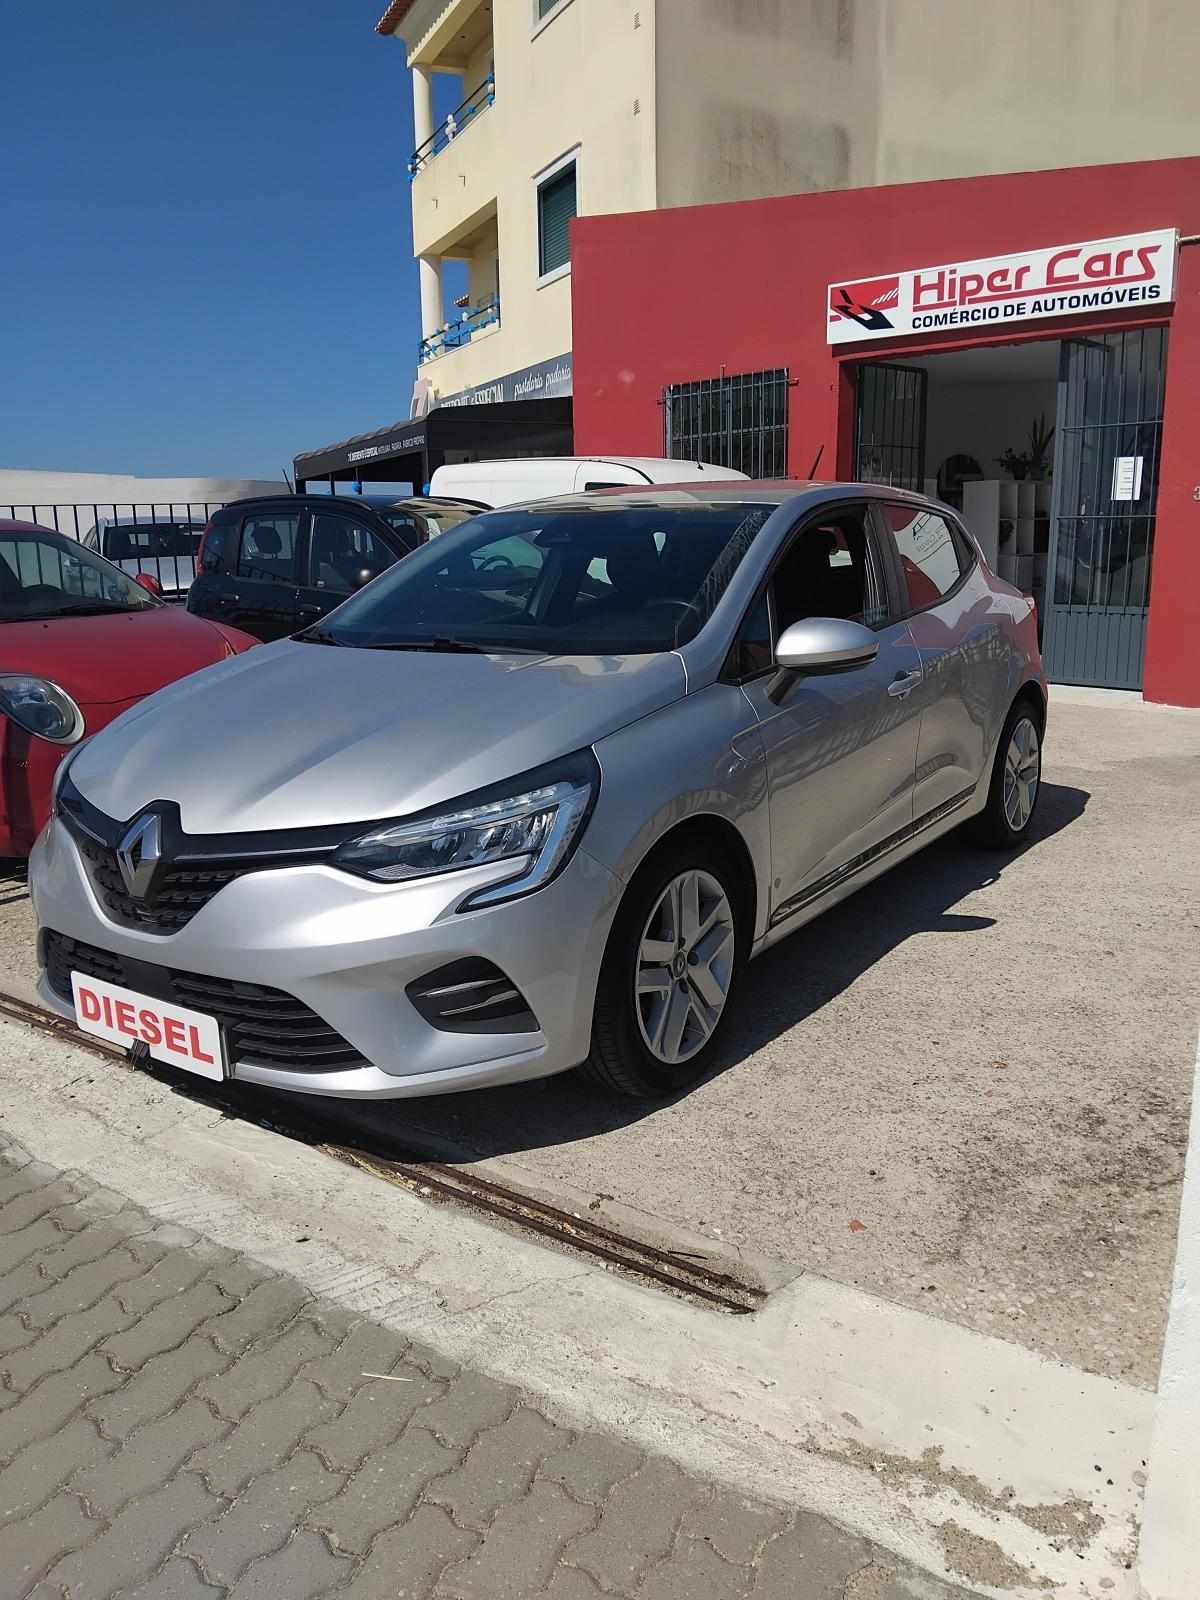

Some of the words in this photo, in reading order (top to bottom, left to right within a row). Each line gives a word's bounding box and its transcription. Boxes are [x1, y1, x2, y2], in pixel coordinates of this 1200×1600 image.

[912, 265, 1030, 306] Hiper
[1046, 244, 1162, 286] Cars
[912, 306, 1000, 329] COMÉRCIO
[1004, 303, 1026, 317] DE
[1031, 284, 1161, 313] AUTOMÓVEIS
[79, 987, 214, 1064] DIESEL
